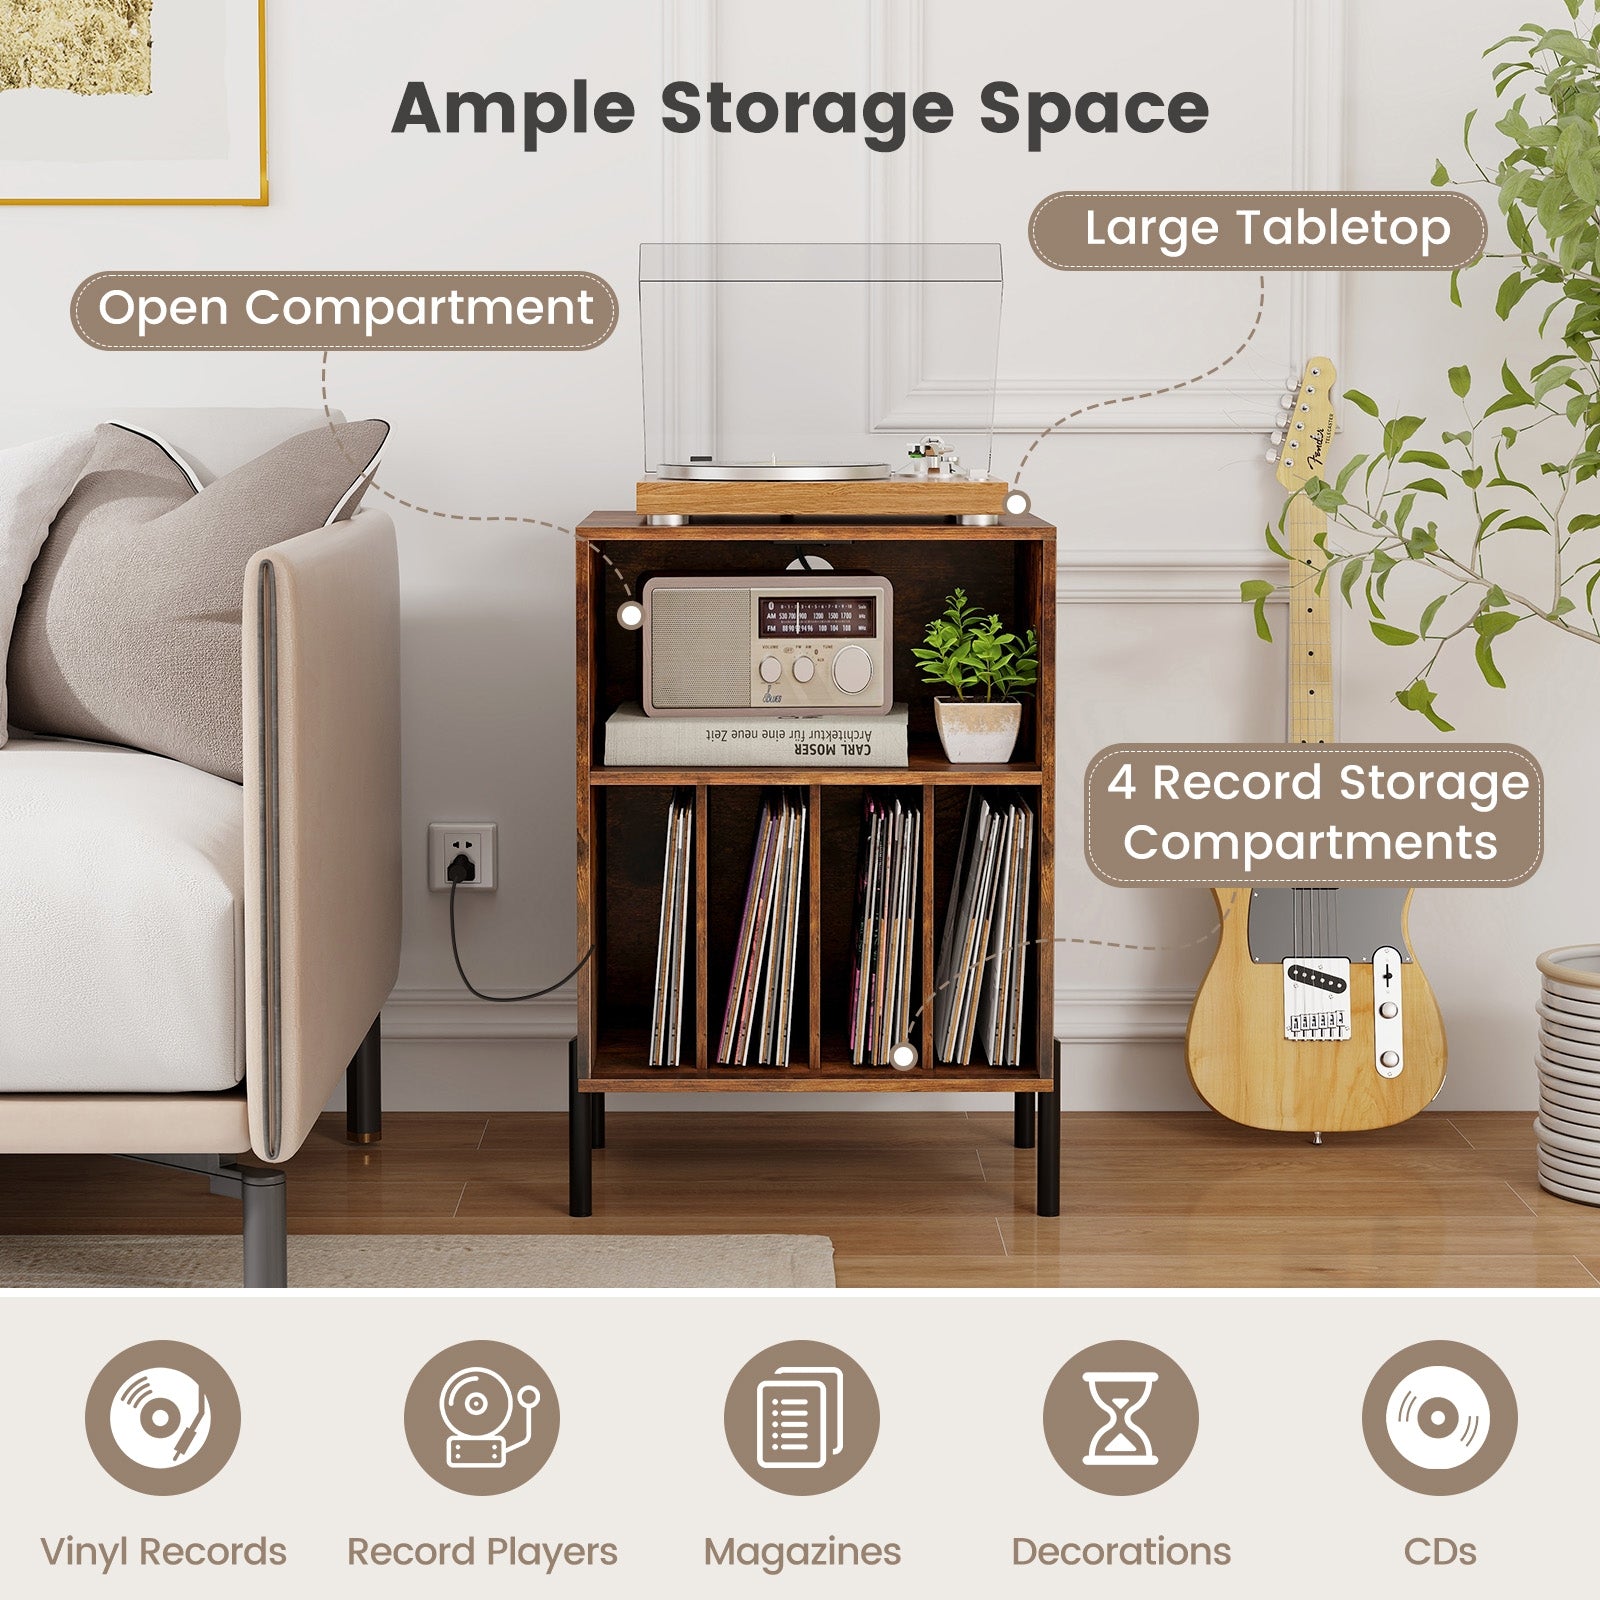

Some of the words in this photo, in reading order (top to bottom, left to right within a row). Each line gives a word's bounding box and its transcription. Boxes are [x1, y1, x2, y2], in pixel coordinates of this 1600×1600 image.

[1325, 413, 1334, 444] TELECASTER
[830, 624, 838, 632] 104
[706, 729, 727, 742] Zeit
[731, 729, 758, 739] neue
[762, 729, 785, 742] eine
[789, 729, 805, 742] für
[808, 729, 872, 742] Architektur
[794, 743, 836, 756] MOSER
[841, 743, 872, 756] CARL
